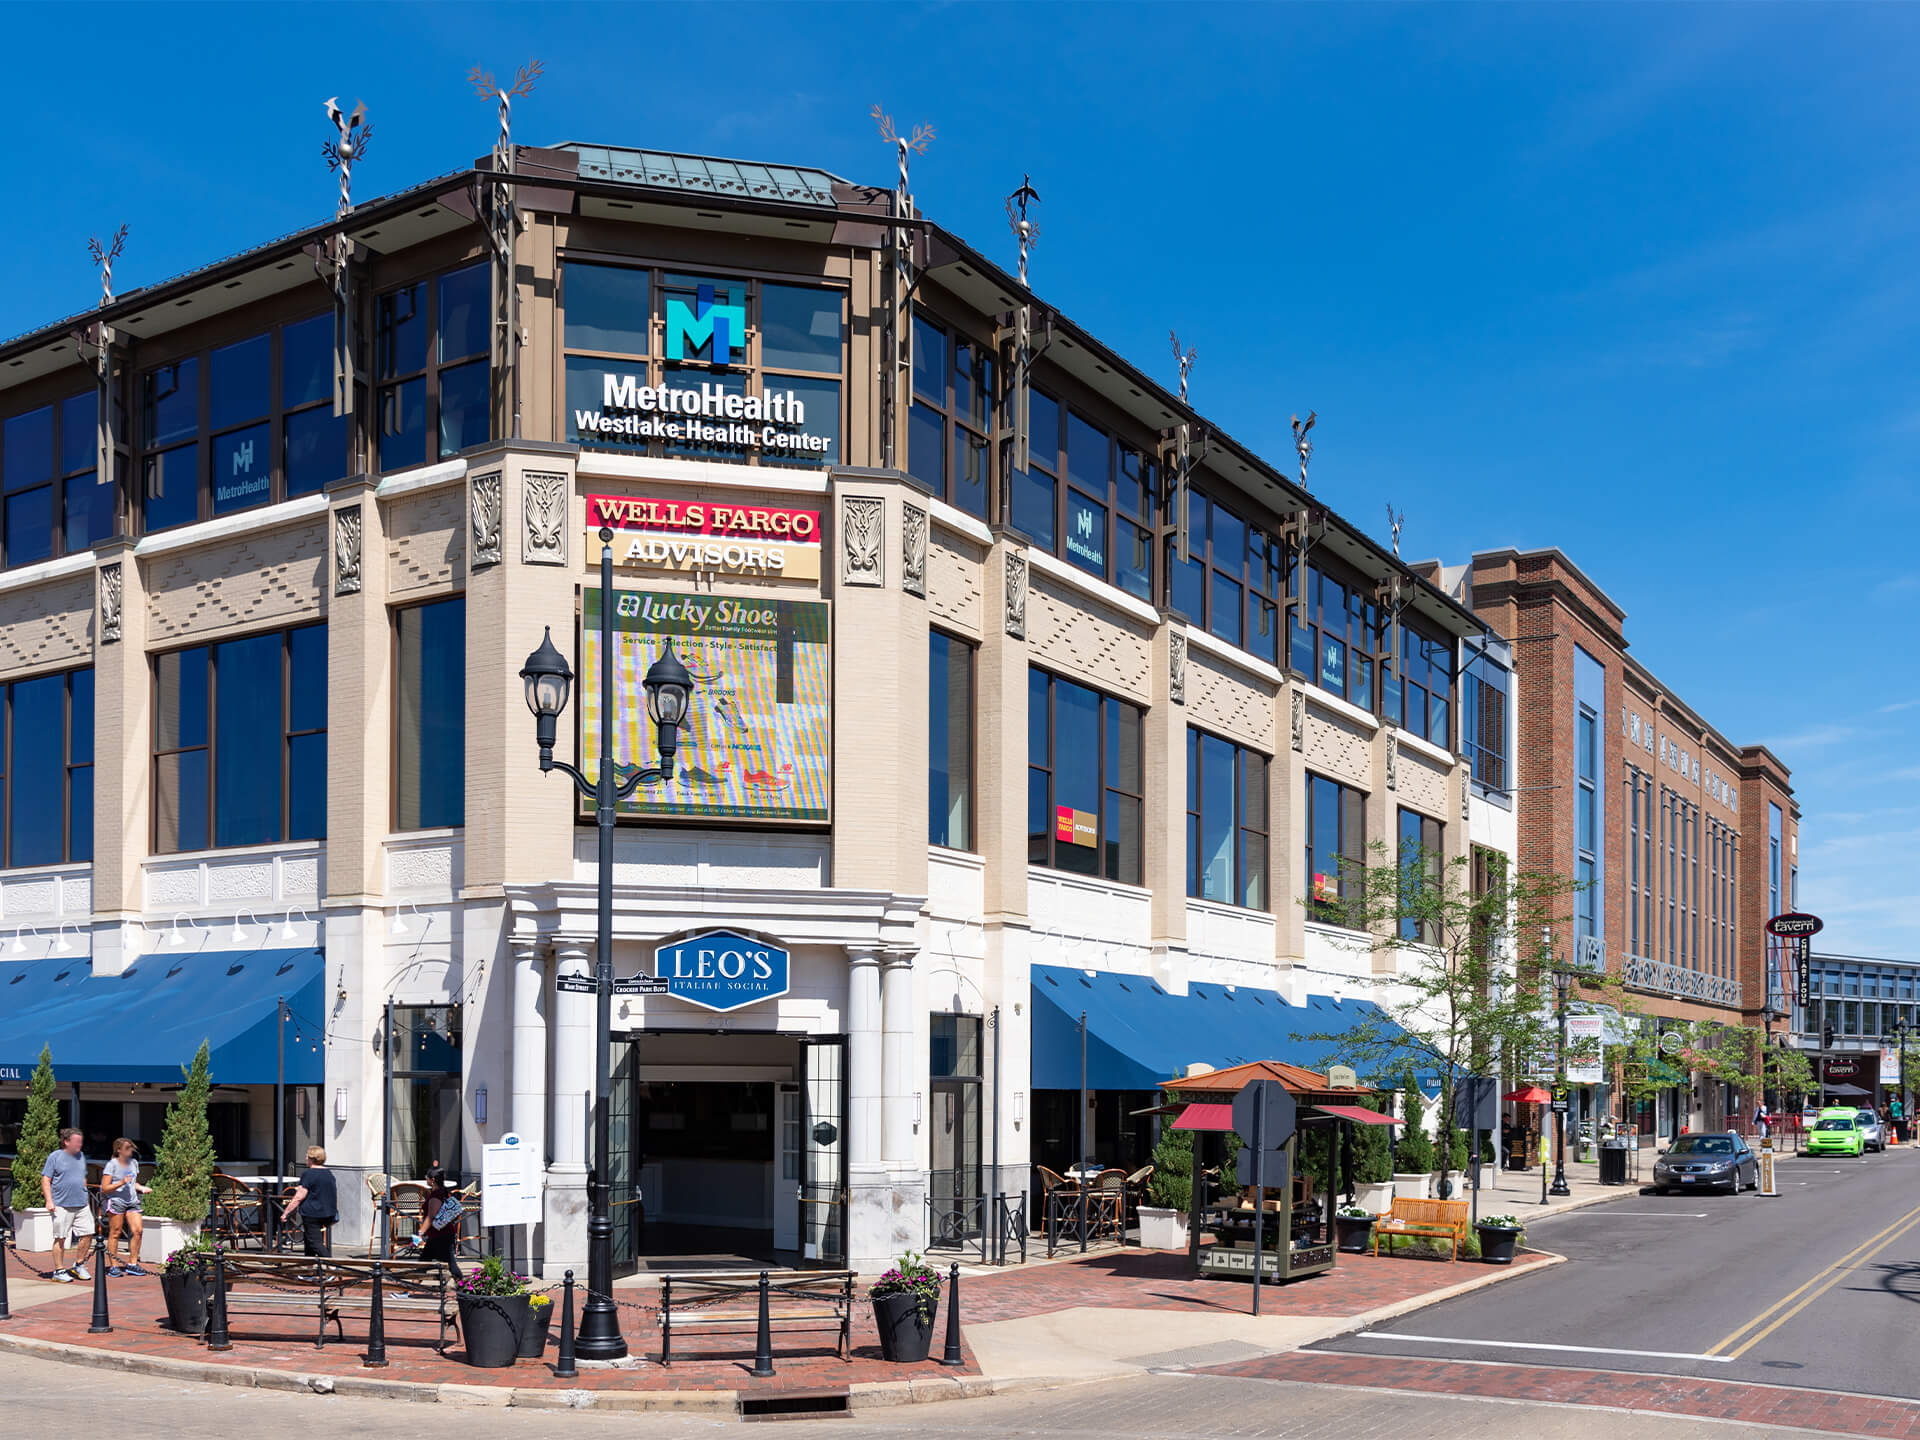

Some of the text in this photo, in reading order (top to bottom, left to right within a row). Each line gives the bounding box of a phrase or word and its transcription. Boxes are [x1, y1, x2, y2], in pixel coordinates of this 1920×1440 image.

[603, 373, 805, 424] MetroHealth
[575, 409, 831, 451] Westlake Health Center
[217, 475, 270, 501] MetroHealth
[595, 498, 814, 535] WELLS FARGO
[624, 538, 785, 570] ADVISORS
[1066, 535, 1103, 566] MetroHealth
[641, 594, 711, 631] Lucky
[622, 637, 778, 652] Service Slection Style Satisfact
[1775, 921, 1815, 932] tavern
[673, 949, 773, 980] LEO'S
[674, 981, 769, 991] ITALIAN SOCIAL
[0, 1067, 21, 1079] CIAL
